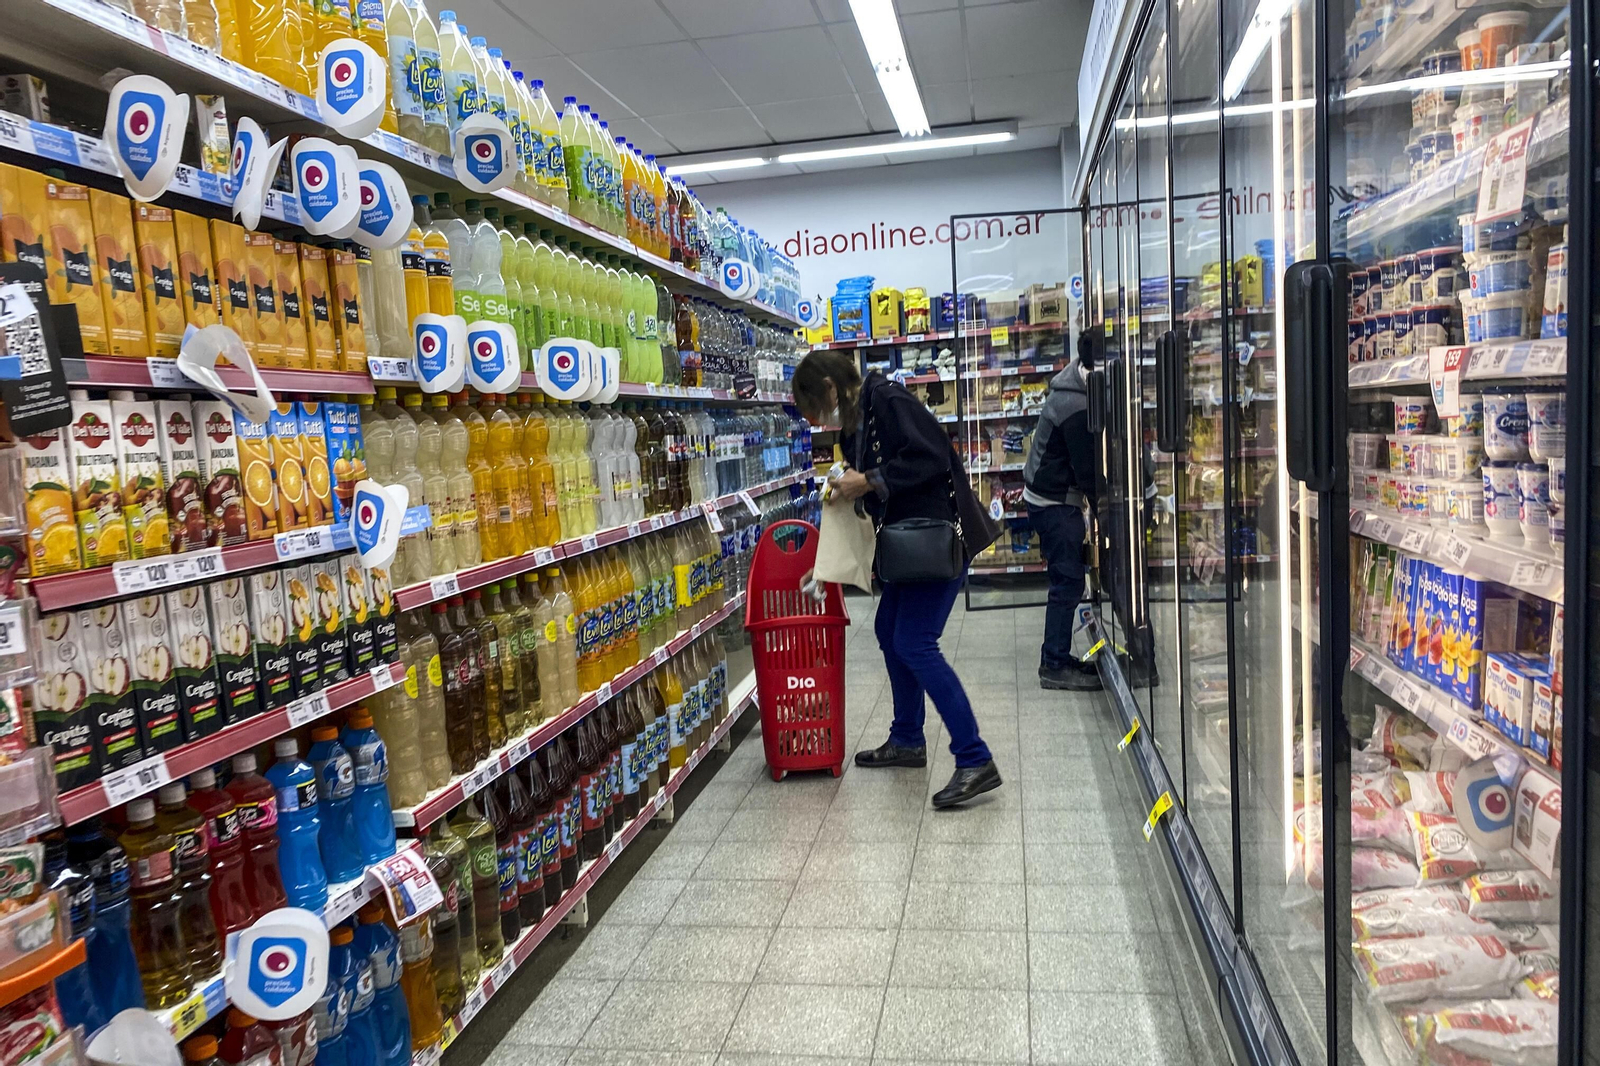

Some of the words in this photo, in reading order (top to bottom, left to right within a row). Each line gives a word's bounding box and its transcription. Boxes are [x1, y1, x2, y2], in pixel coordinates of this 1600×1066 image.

[335, 88, 354, 97] precios
[336, 93, 358, 101] cuidados
[129, 146, 149, 155] precios
[129, 153, 152, 163] cuidados
[308, 194, 328, 203] precios
[309, 200, 333, 208] cuidados
[364, 209, 384, 221] precios
[365, 214, 390, 226] cuidados
[783, 212, 1045, 259] diaonline.com.ar
[66, 259, 90, 273] Cepita
[110, 268, 132, 281] Cepita
[154, 275, 173, 288] Cepita
[192, 282, 210, 293] Cepita
[230, 287, 247, 299] Cepita
[256, 293, 274, 304] Cepita
[284, 299, 298, 310] Cepita
[313, 303, 327, 314] Cepita
[462, 295, 480, 312] Se
[480, 362, 497, 370] precios
[328, 410, 346, 425] Tutti
[88, 427, 109, 437] Valle
[135, 426, 154, 436] Valle
[178, 424, 192, 434] Valle
[217, 422, 233, 433] Valle
[276, 421, 297, 436] Tutti
[304, 420, 322, 436] Tutti
[26, 456, 59, 468] NARANJA
[377, 621, 396, 636] Cepita
[352, 629, 373, 644] Cepita
[321, 638, 344, 655] Cepita
[295, 647, 318, 663] Cepita
[265, 655, 290, 672] Cepita
[226, 666, 255, 684] Cepita
[186, 680, 216, 698] Cepita
[1501, 677, 1522, 699] Crema
[143, 693, 176, 713] Cepita
[98, 707, 135, 727] Cepita
[44, 724, 90, 745] Cepita
[264, 979, 291, 988] precios
[264, 985, 296, 993] cuidados
